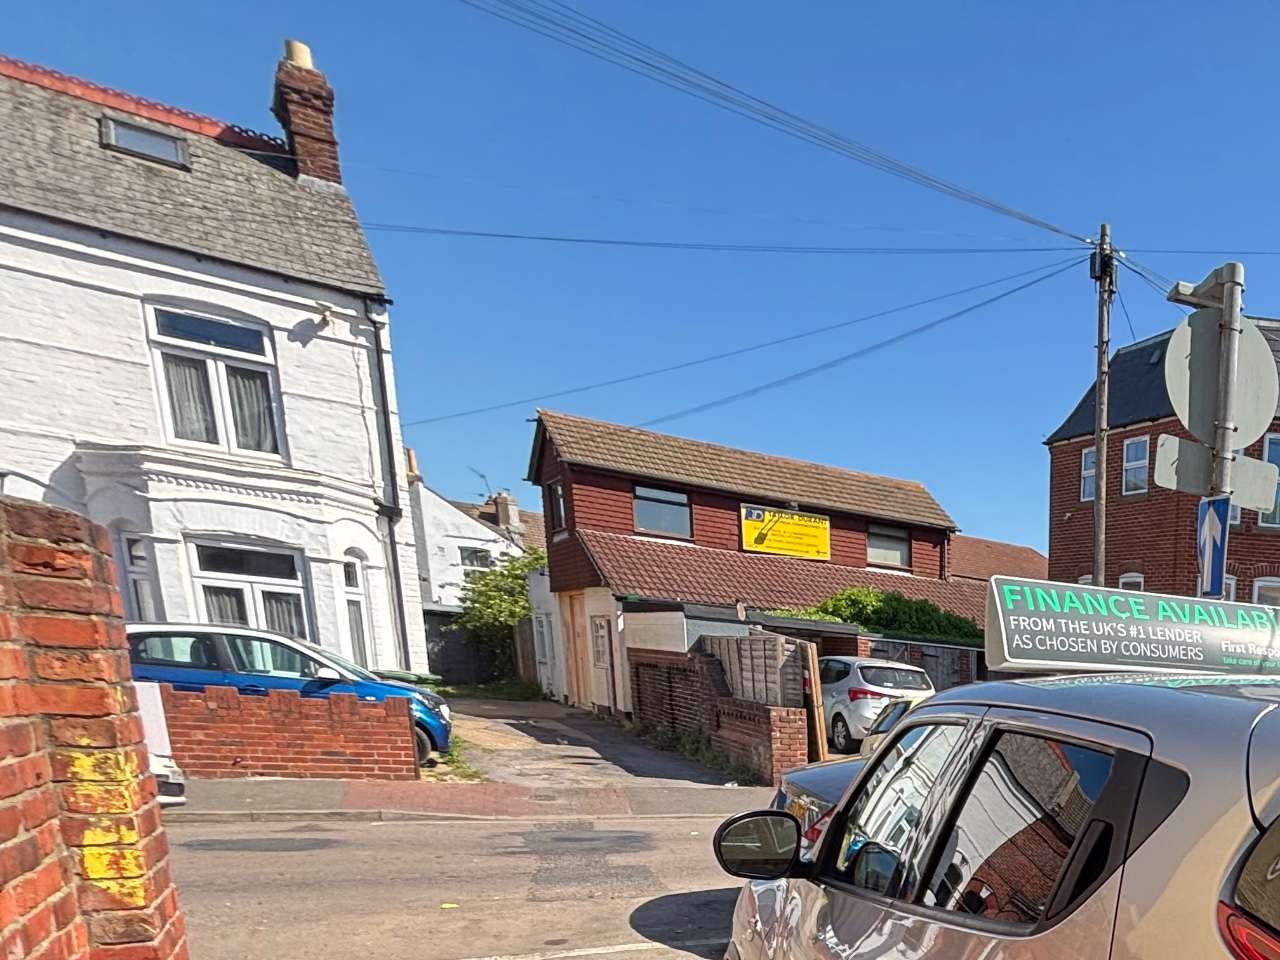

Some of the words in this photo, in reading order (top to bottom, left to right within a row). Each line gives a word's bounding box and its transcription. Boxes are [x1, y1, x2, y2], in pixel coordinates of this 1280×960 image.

[1002, 584, 1150, 620] FINANCE
[1009, 615, 1055, 632] FROM
[1057, 619, 1090, 634] THE
[1092, 621, 1127, 637] UK'S
[1129, 624, 1146, 638] #1
[1148, 626, 1203, 643] LENDER
[1012, 634, 1033, 649] AS
[1035, 635, 1098, 653] CHOSEN
[1101, 639, 1118, 654] BY
[1120, 641, 1204, 661] CONSUMERS
[1221, 640, 1247, 654] First
